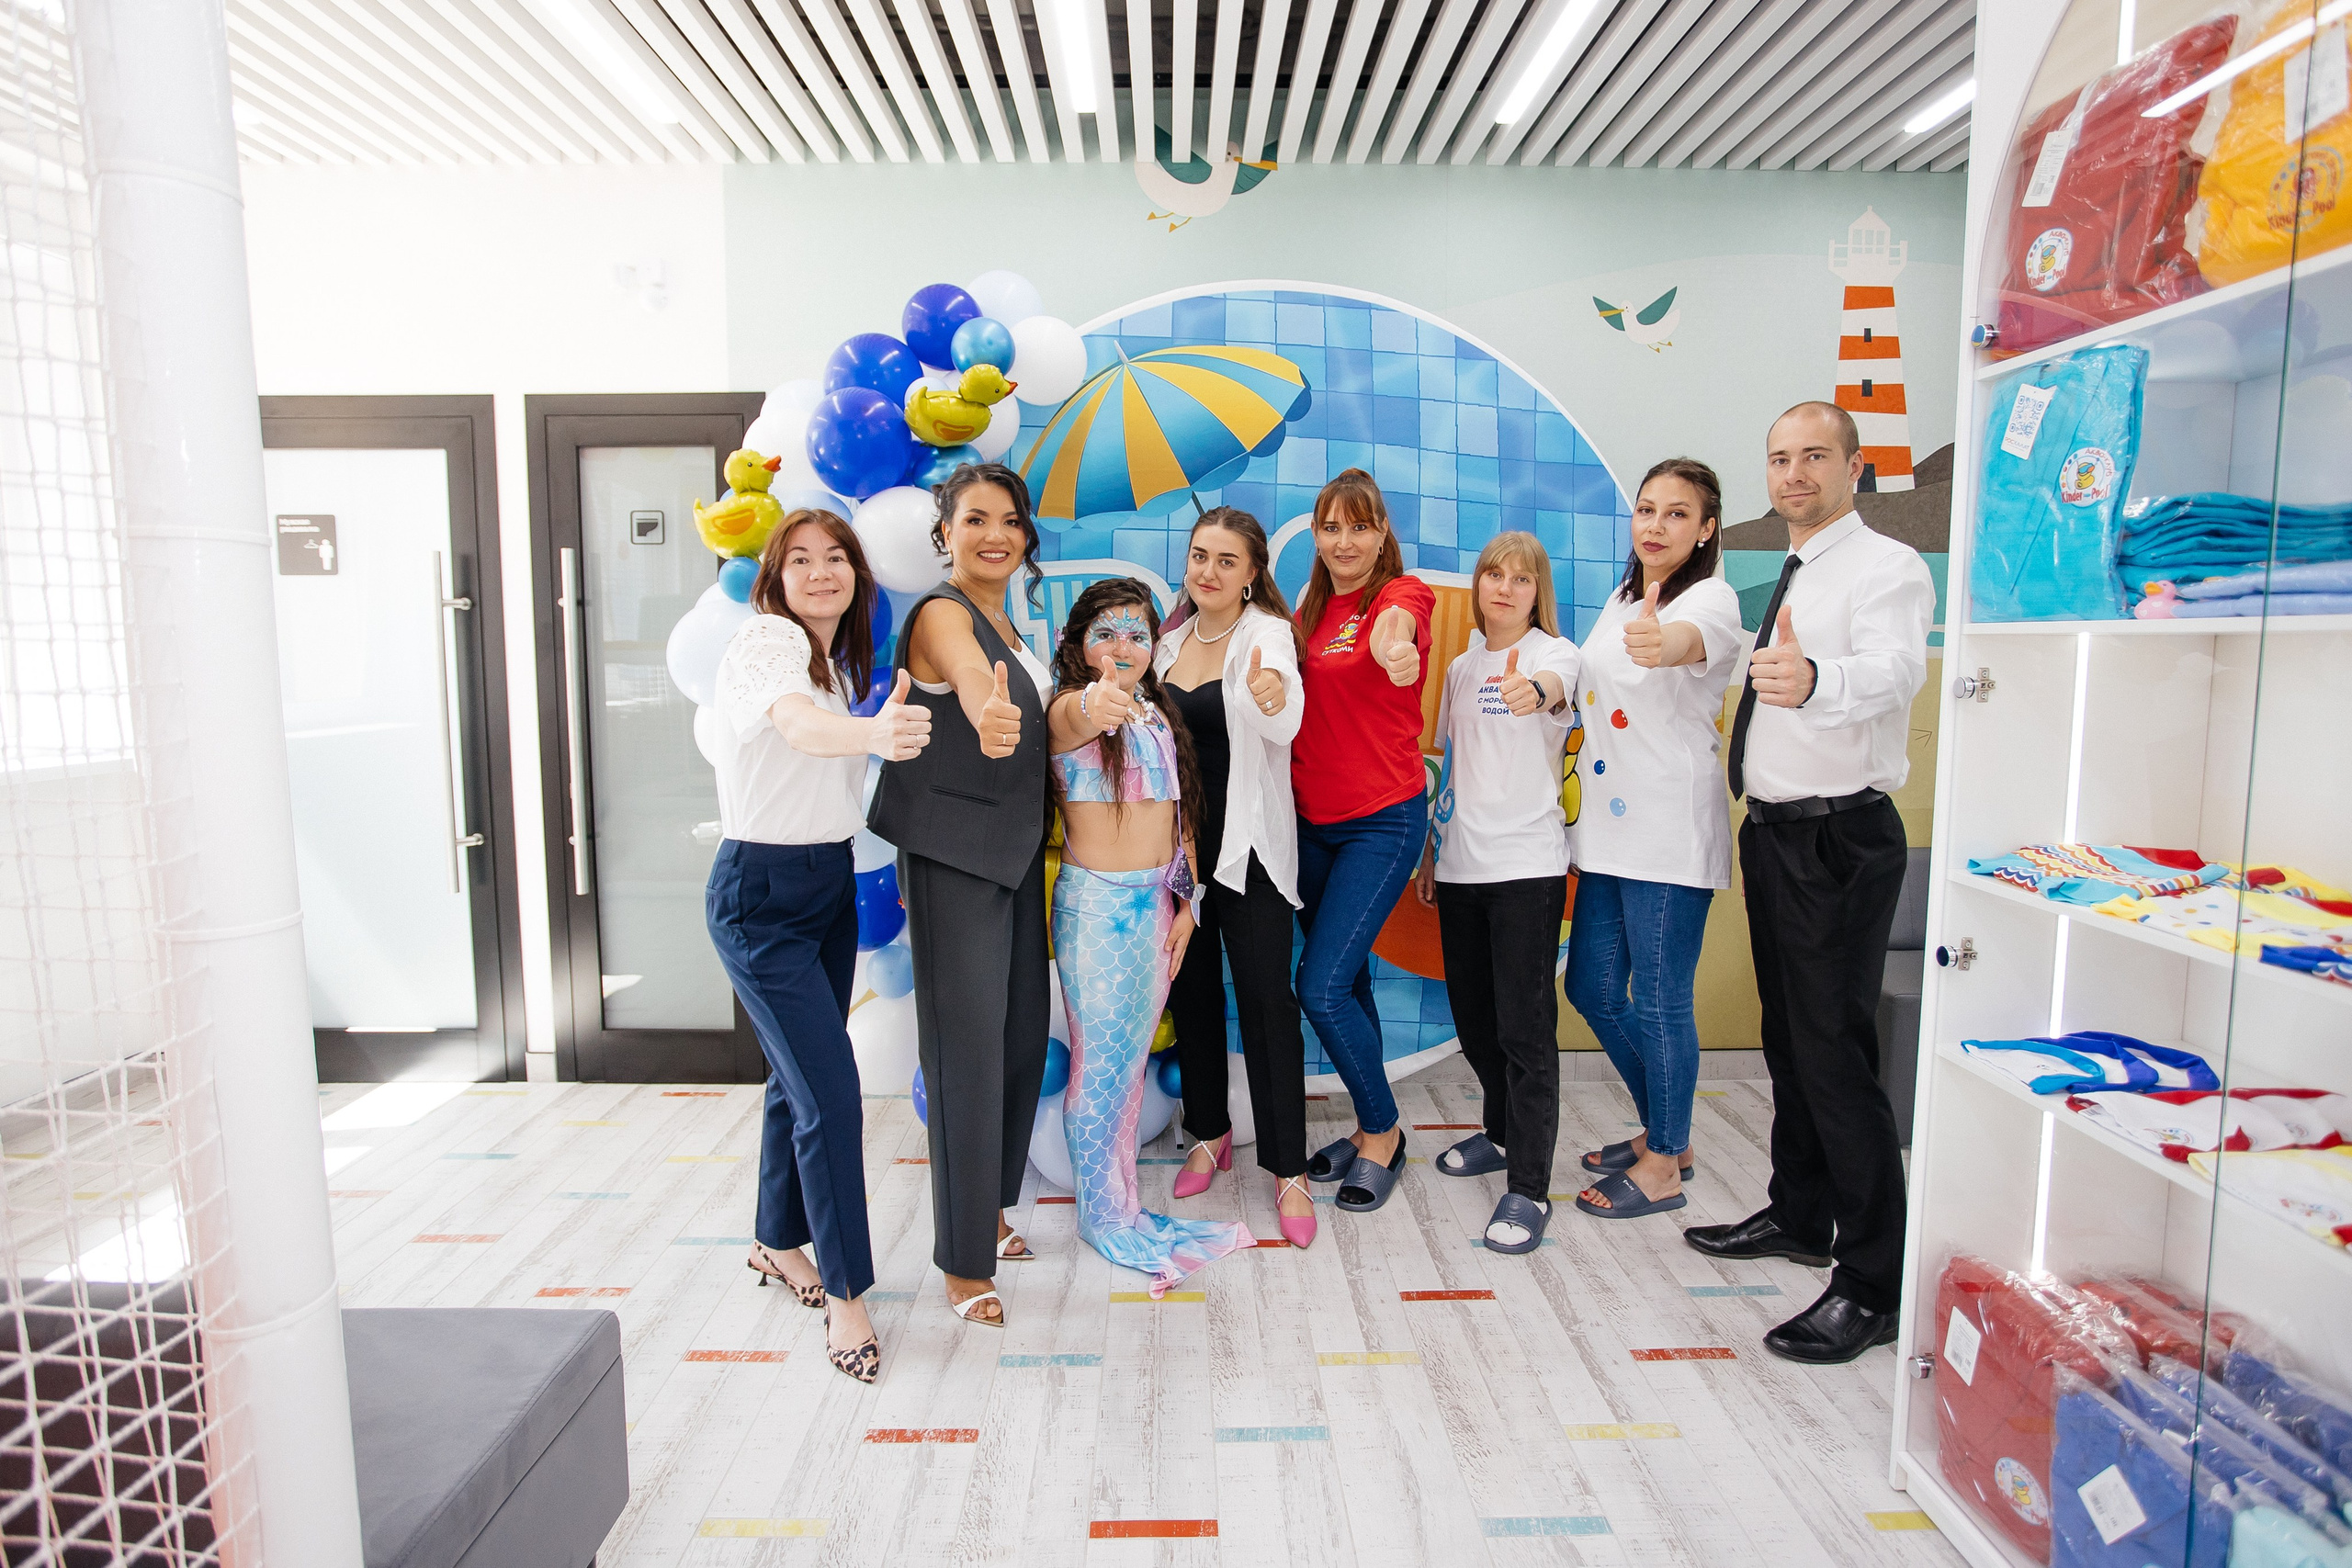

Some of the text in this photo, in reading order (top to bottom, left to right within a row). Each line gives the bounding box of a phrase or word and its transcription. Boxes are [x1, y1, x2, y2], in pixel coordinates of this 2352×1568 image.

[2061, 489, 2082, 503] Kinder
[1477, 685, 1499, 694] АКВА
[1482, 706, 1510, 716] ВОДОЙ
